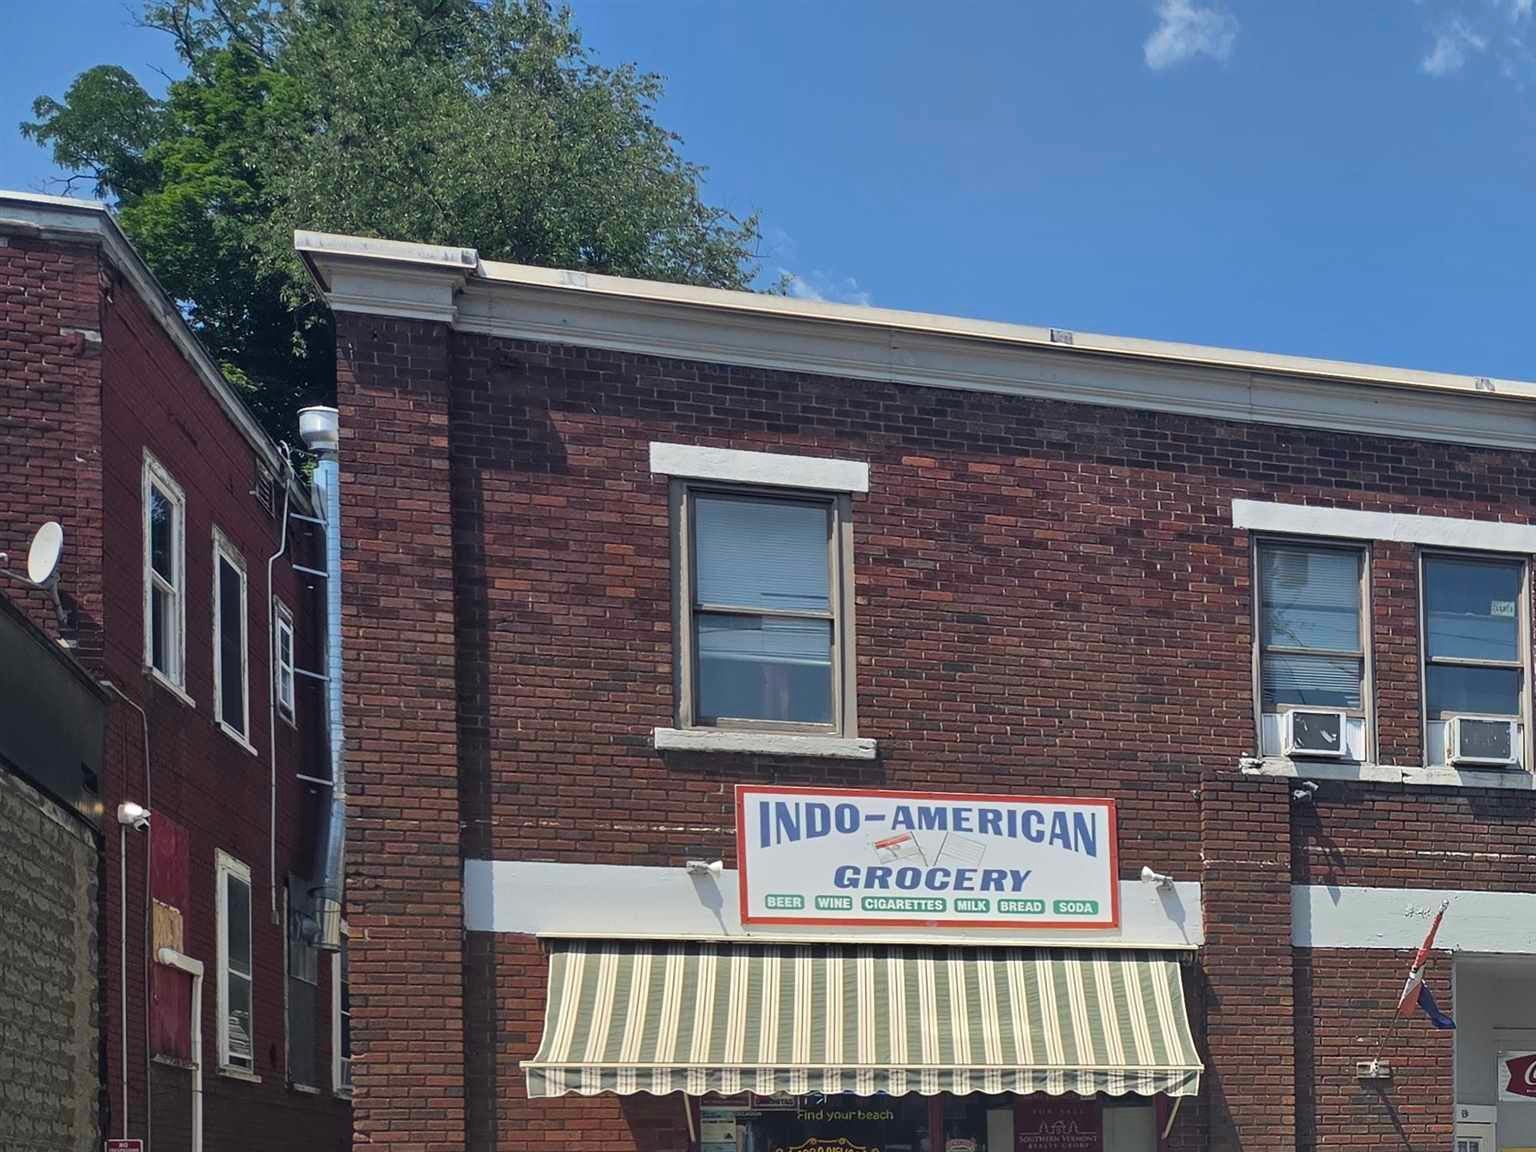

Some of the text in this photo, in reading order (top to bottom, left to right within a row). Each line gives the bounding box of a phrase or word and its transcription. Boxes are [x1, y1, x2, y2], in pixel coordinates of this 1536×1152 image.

[760, 801, 1097, 857] INDO-AMERICAN
[834, 865, 1032, 892] GROCERY
[767, 896, 1093, 913] BEER WINE CIGARETTES MILK BREAD SODA
[827, 1111, 854, 1122] your
[858, 1109, 894, 1121] beach
